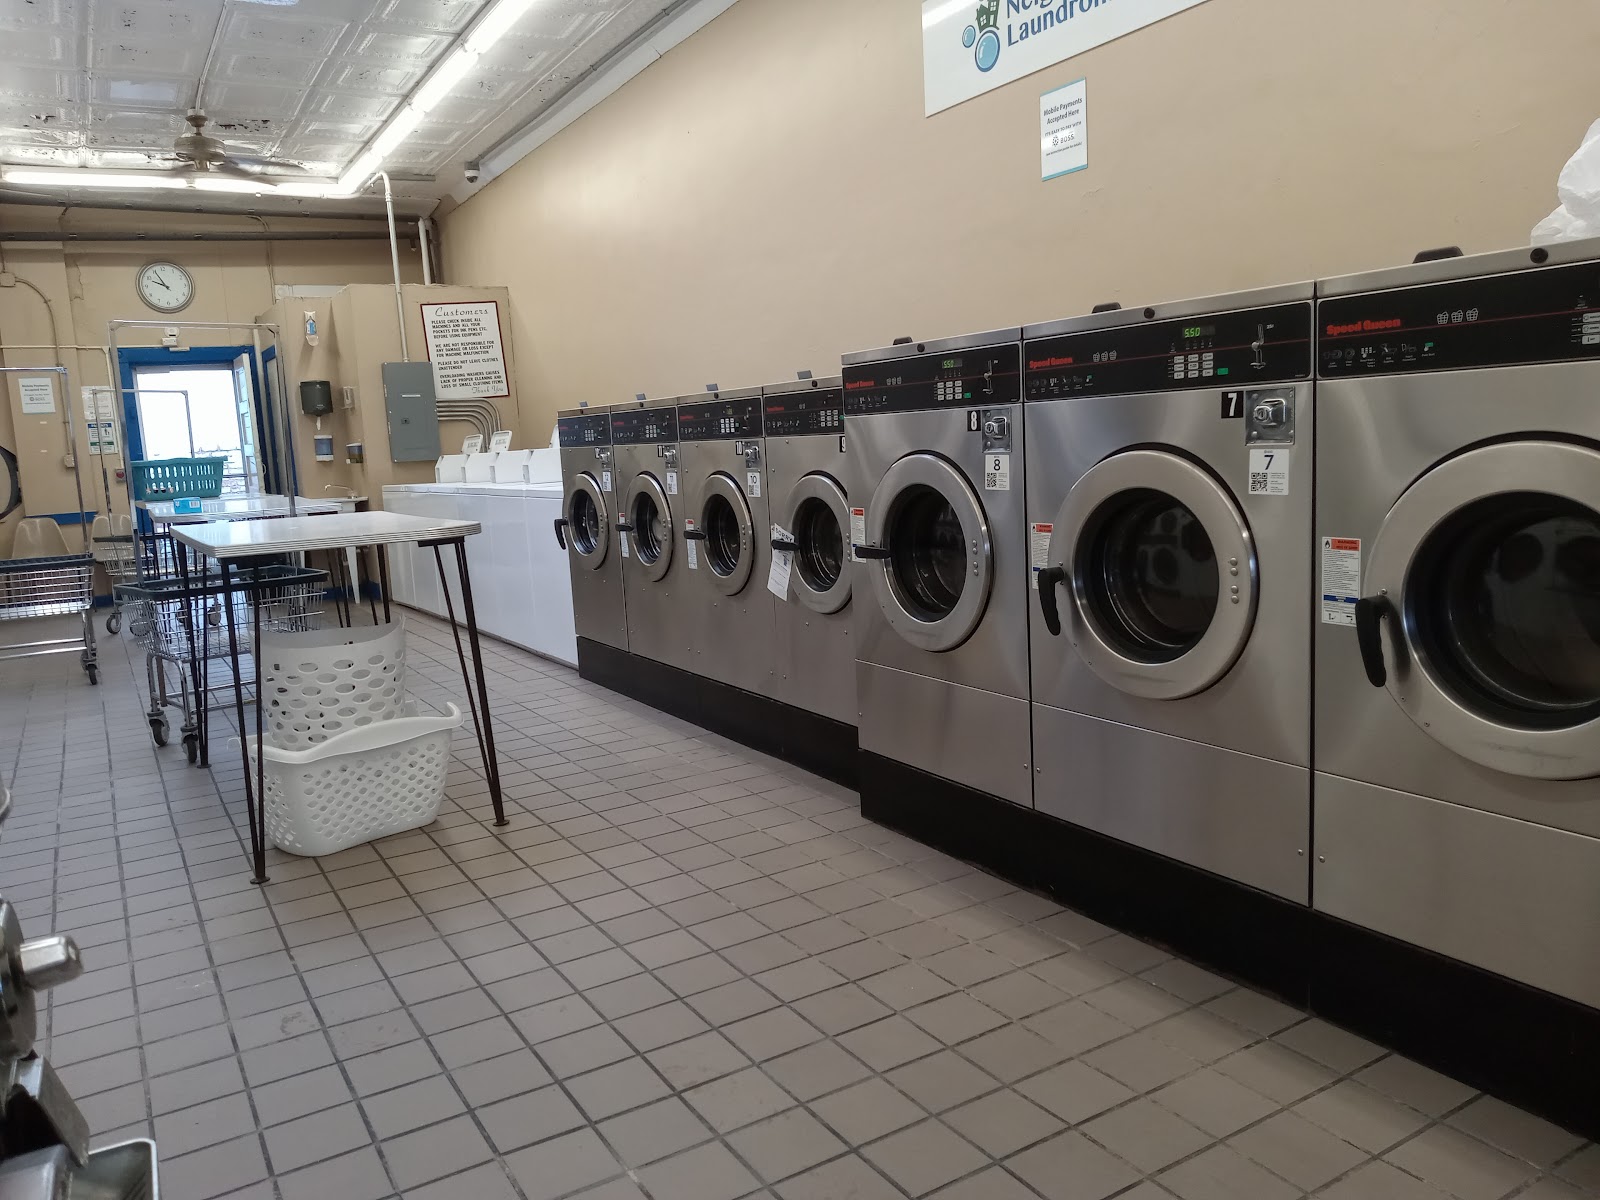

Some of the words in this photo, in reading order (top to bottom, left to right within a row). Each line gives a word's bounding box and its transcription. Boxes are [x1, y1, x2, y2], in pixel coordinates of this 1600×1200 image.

[1008, 0, 1113, 47] Laundro
[1044, 105, 1059, 116] Mobile
[1060, 98, 1082, 110] Payments
[1046, 112, 1068, 124] Accepted
[1068, 109, 1080, 118] Here
[435, 306, 488, 317] Customers
[1327, 321, 1362, 336] Speed
[1363, 319, 1400, 330] Queen
[1030, 358, 1050, 368] Speed
[1051, 357, 1073, 365] Queen
[1228, 392, 1237, 416] 7
[971, 411, 977, 430] 8
[736, 442, 743, 455] 10
[994, 459, 1000, 471] 8
[1264, 454, 1274, 470] 7
[750, 475, 757, 484] 10
